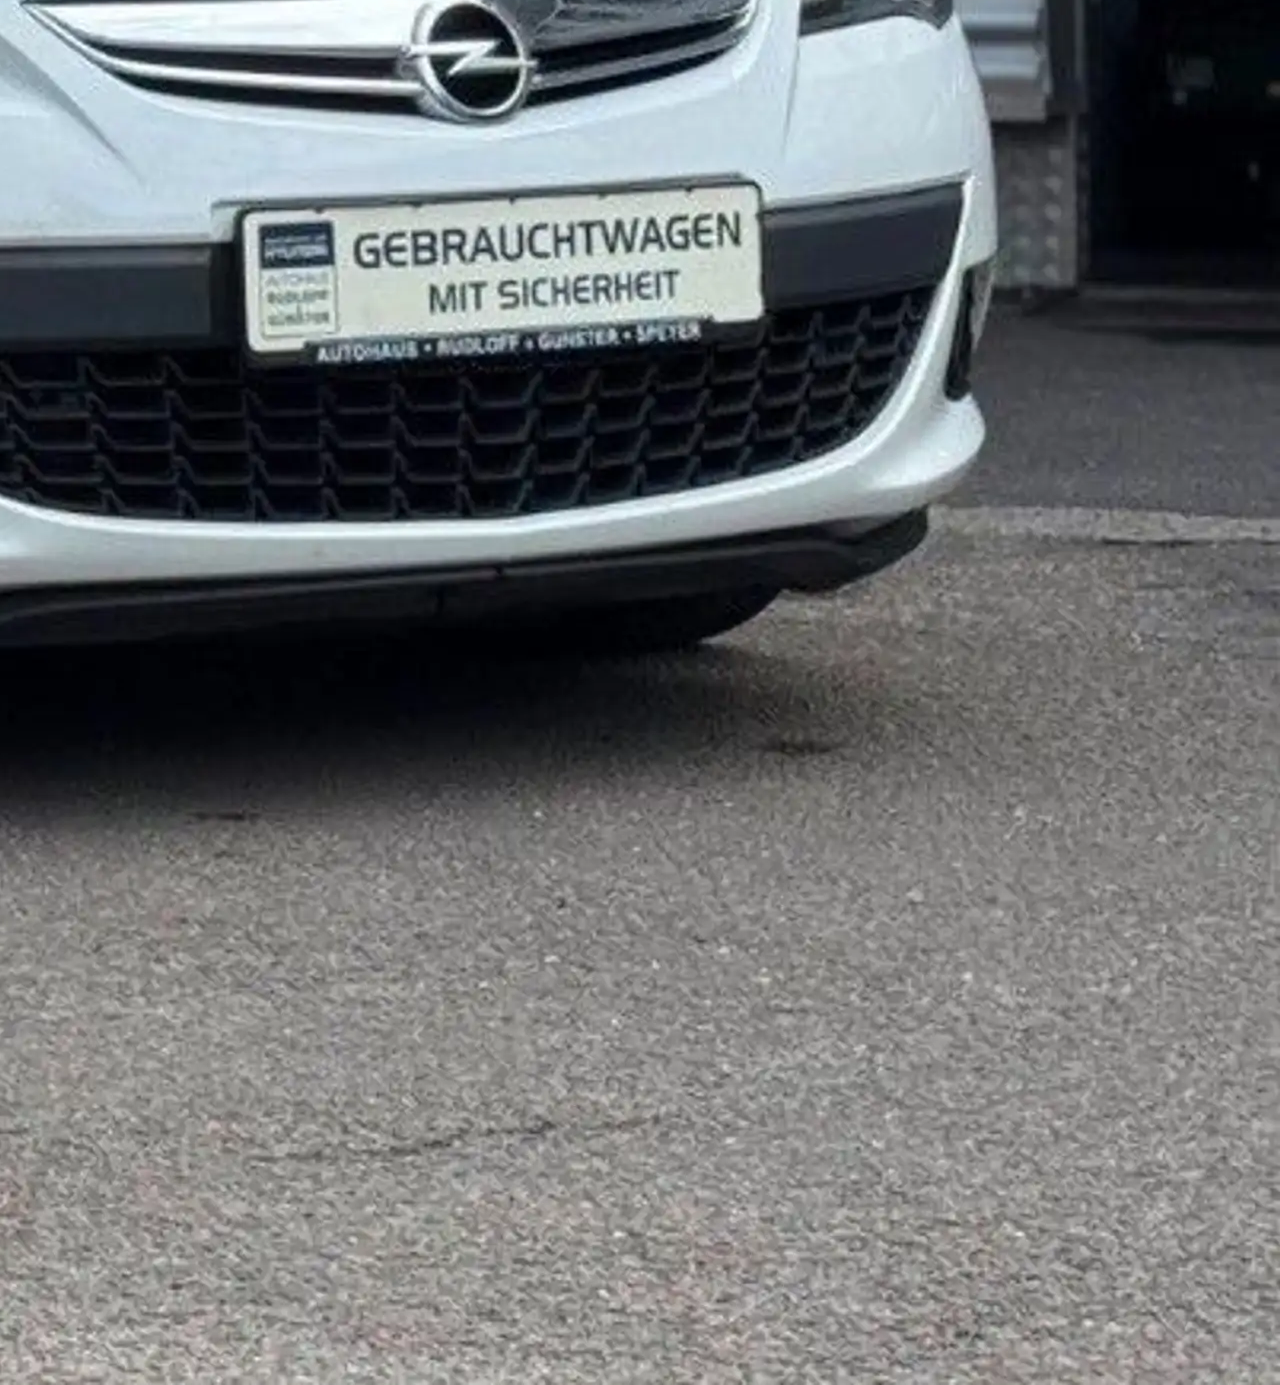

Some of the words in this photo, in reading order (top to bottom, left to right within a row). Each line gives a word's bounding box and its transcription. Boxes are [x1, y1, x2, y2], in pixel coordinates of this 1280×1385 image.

[353, 210, 741, 268] GEBRAUCHTWAGEN
[428, 279, 488, 314] MIT
[497, 269, 680, 310] SICHERHEIT
[316, 339, 418, 362] AUTOHAUS
